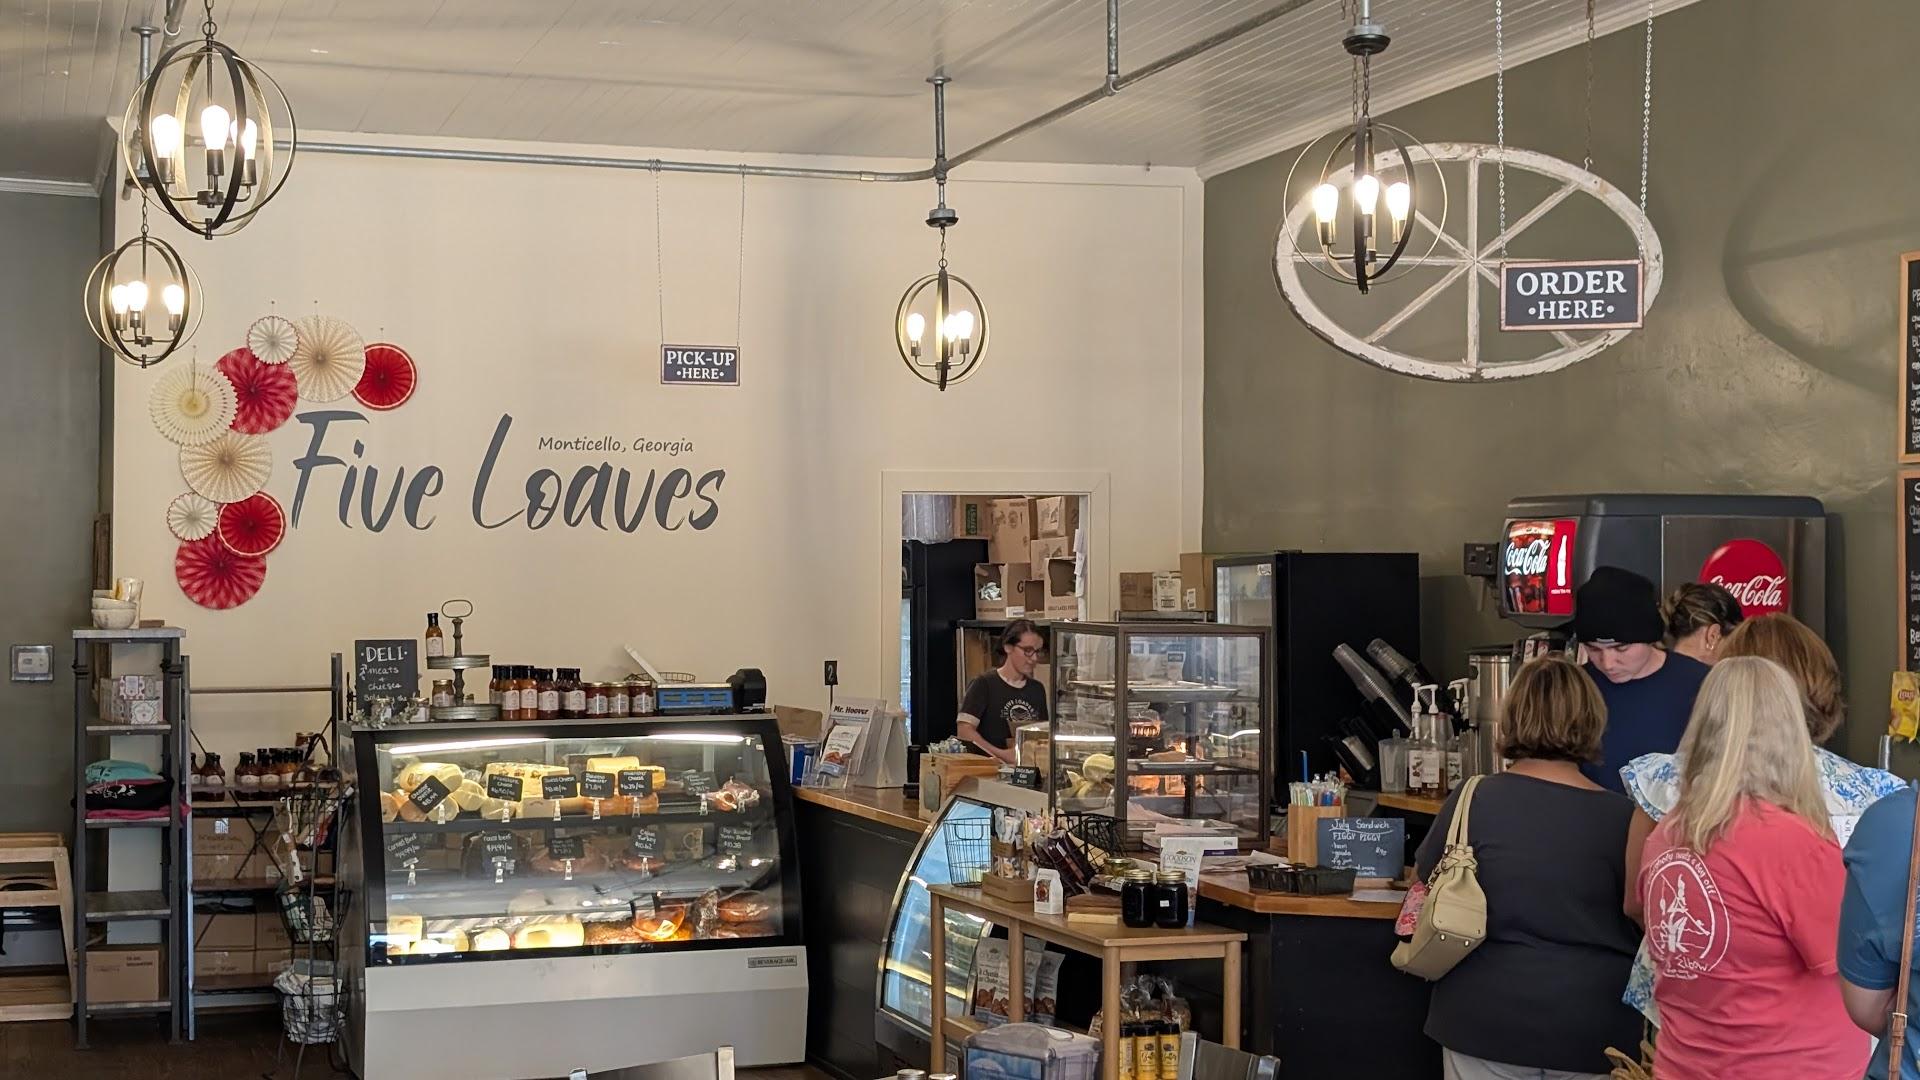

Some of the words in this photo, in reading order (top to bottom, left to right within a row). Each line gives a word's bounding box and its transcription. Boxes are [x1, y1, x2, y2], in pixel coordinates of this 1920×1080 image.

[1516, 270, 1627, 296] ORDER
[666, 350, 735, 366] PICK-UP
[539, 436, 627, 454] Monticello,
[633, 437, 693, 456] Georgia
[291, 411, 443, 531] Five
[473, 413, 726, 533] Loaves
[365, 646, 404, 662] DELI
[845, 706, 869, 715] Hoover
[1332, 819, 1350, 832] July
[1356, 818, 1390, 829] Sandwich
[1333, 832, 1356, 840] FIGGY
[1703, 879, 1716, 894] off
